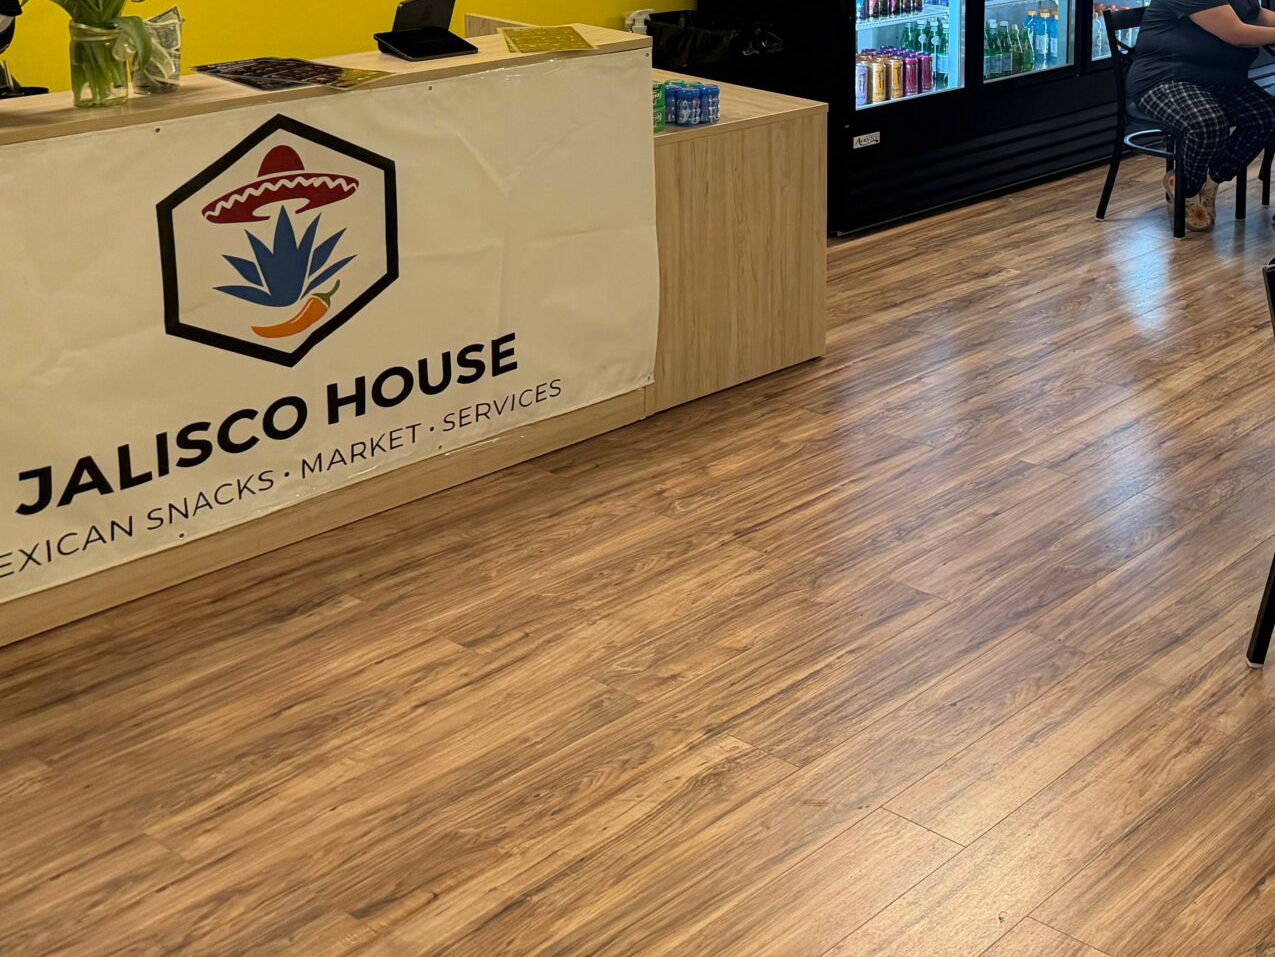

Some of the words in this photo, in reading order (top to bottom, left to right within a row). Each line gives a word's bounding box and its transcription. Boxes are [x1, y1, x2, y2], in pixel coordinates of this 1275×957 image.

[16, 396, 308, 516] JALISCO
[327, 332, 518, 425] HOUSE
[147, 470, 274, 531] SNACKS
[301, 423, 421, 479] MARKET
[443, 379, 562, 432] SERVICES
